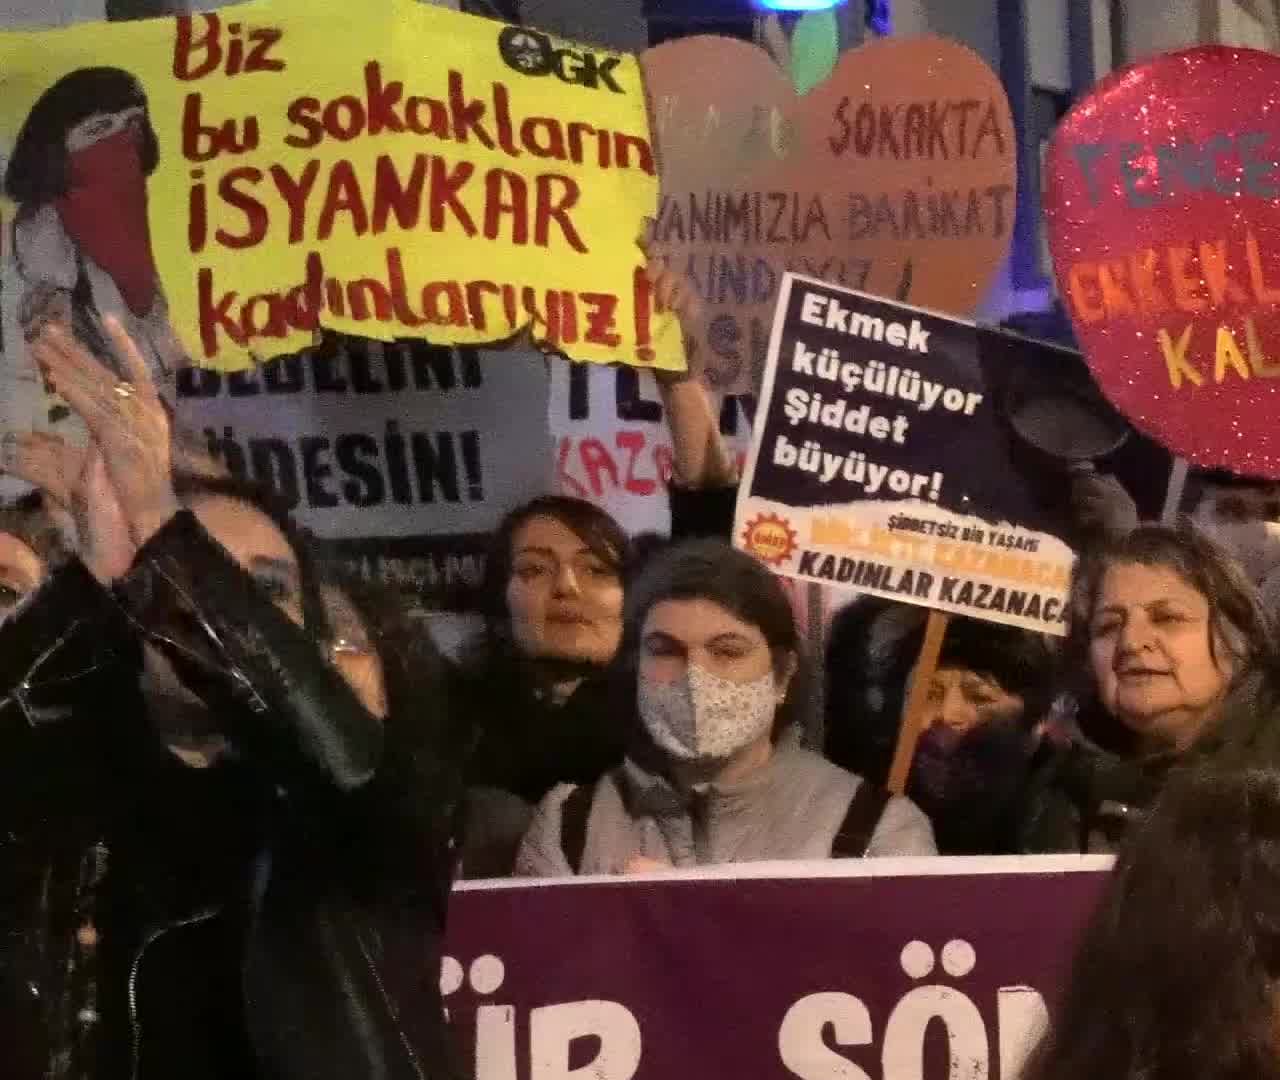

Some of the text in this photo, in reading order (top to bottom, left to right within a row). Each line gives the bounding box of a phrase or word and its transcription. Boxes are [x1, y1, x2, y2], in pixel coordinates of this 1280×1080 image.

[173, 11, 286, 82] Biz
[182, 92, 260, 163] bu
[284, 60, 656, 176] sokakların
[827, 96, 1005, 161] SOKAKTA
[188, 154, 590, 256] İSYANKAR
[801, 292, 931, 354] Ekmek
[791, 341, 984, 416] küçülüyor
[783, 387, 910, 445] Şiddet
[772, 434, 945, 502] büyüyor!
[797, 549, 936, 600] KADINLAR
